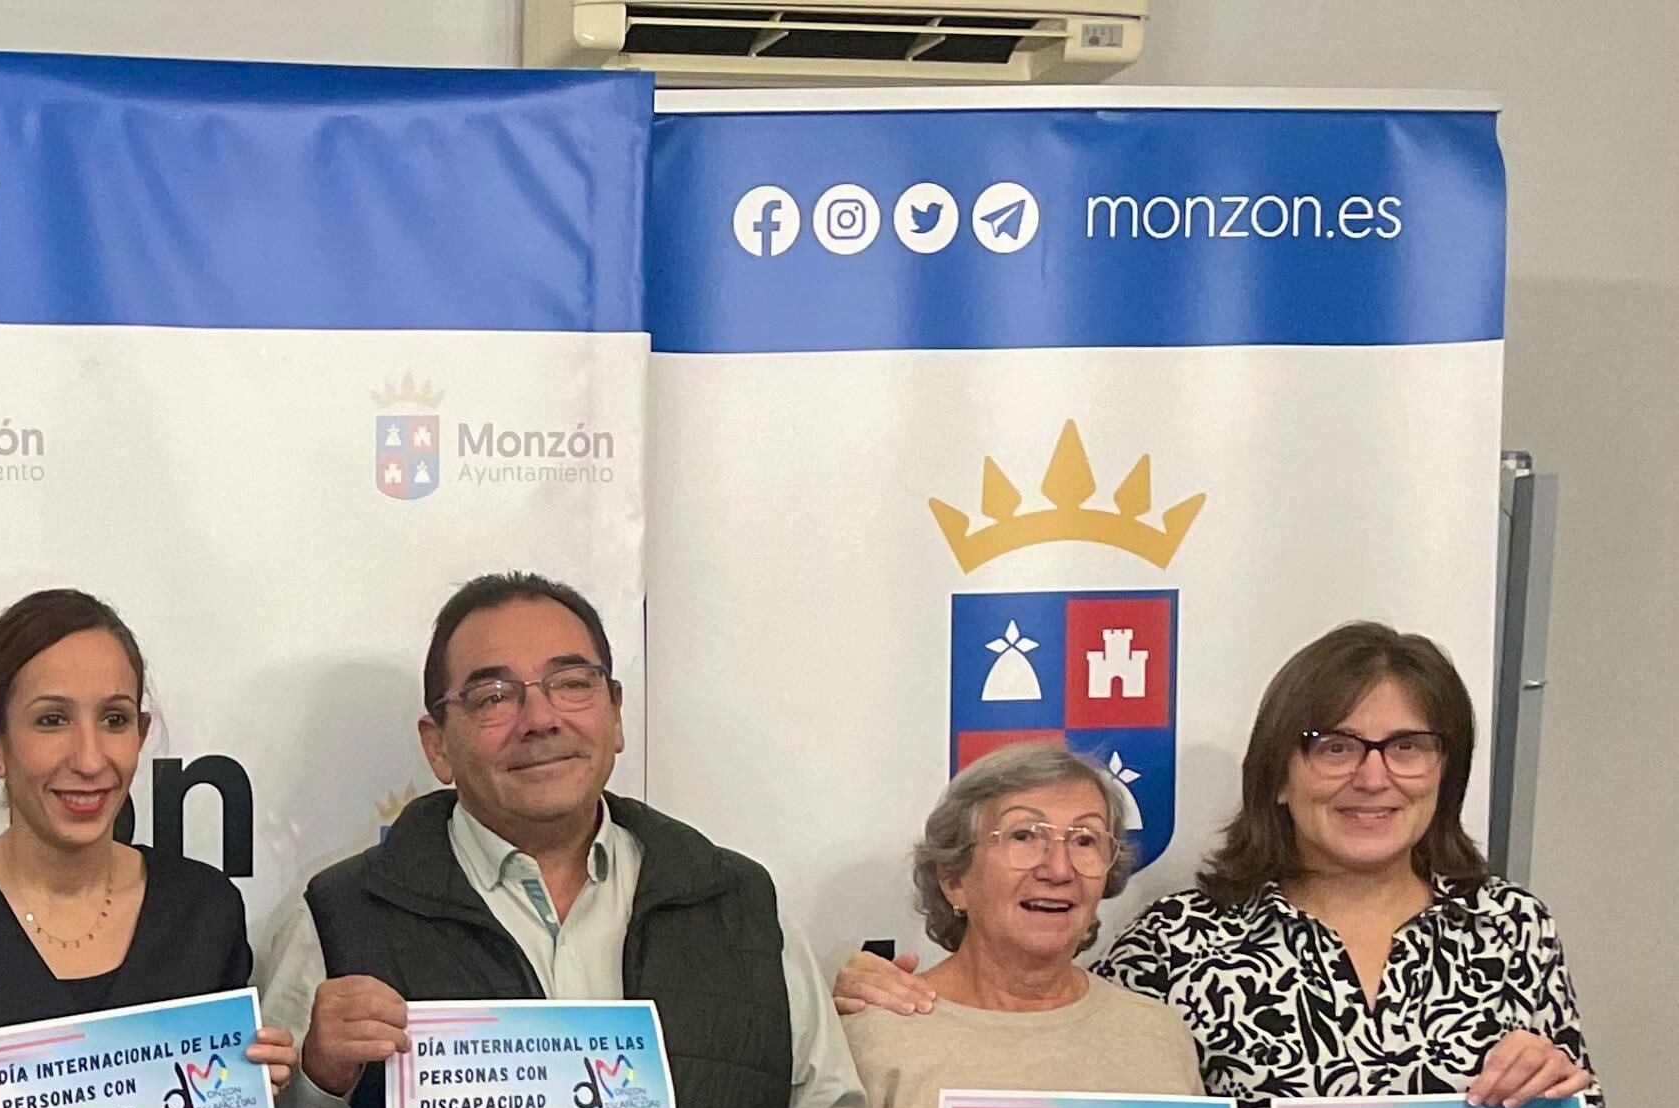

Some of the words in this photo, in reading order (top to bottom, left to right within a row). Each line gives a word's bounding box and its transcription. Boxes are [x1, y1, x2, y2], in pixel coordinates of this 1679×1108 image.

[1085, 195, 1402, 240] monzon.es
[458, 423, 614, 458] Monzón
[458, 463, 613, 485] Ayuntamiento
[37, 1043, 173, 1079] INTERNACIONAL
[181, 1037, 202, 1055] DE
[210, 1031, 242, 1050] LAS
[418, 1037, 445, 1057] DÍA
[454, 1037, 583, 1055] INTERNACIONAL
[589, 1037, 608, 1051] DE
[616, 1036, 644, 1050] LAS
[419, 1067, 508, 1085] PERSONAS
[516, 1066, 547, 1081] CON
[104, 1078, 137, 1098] CON
